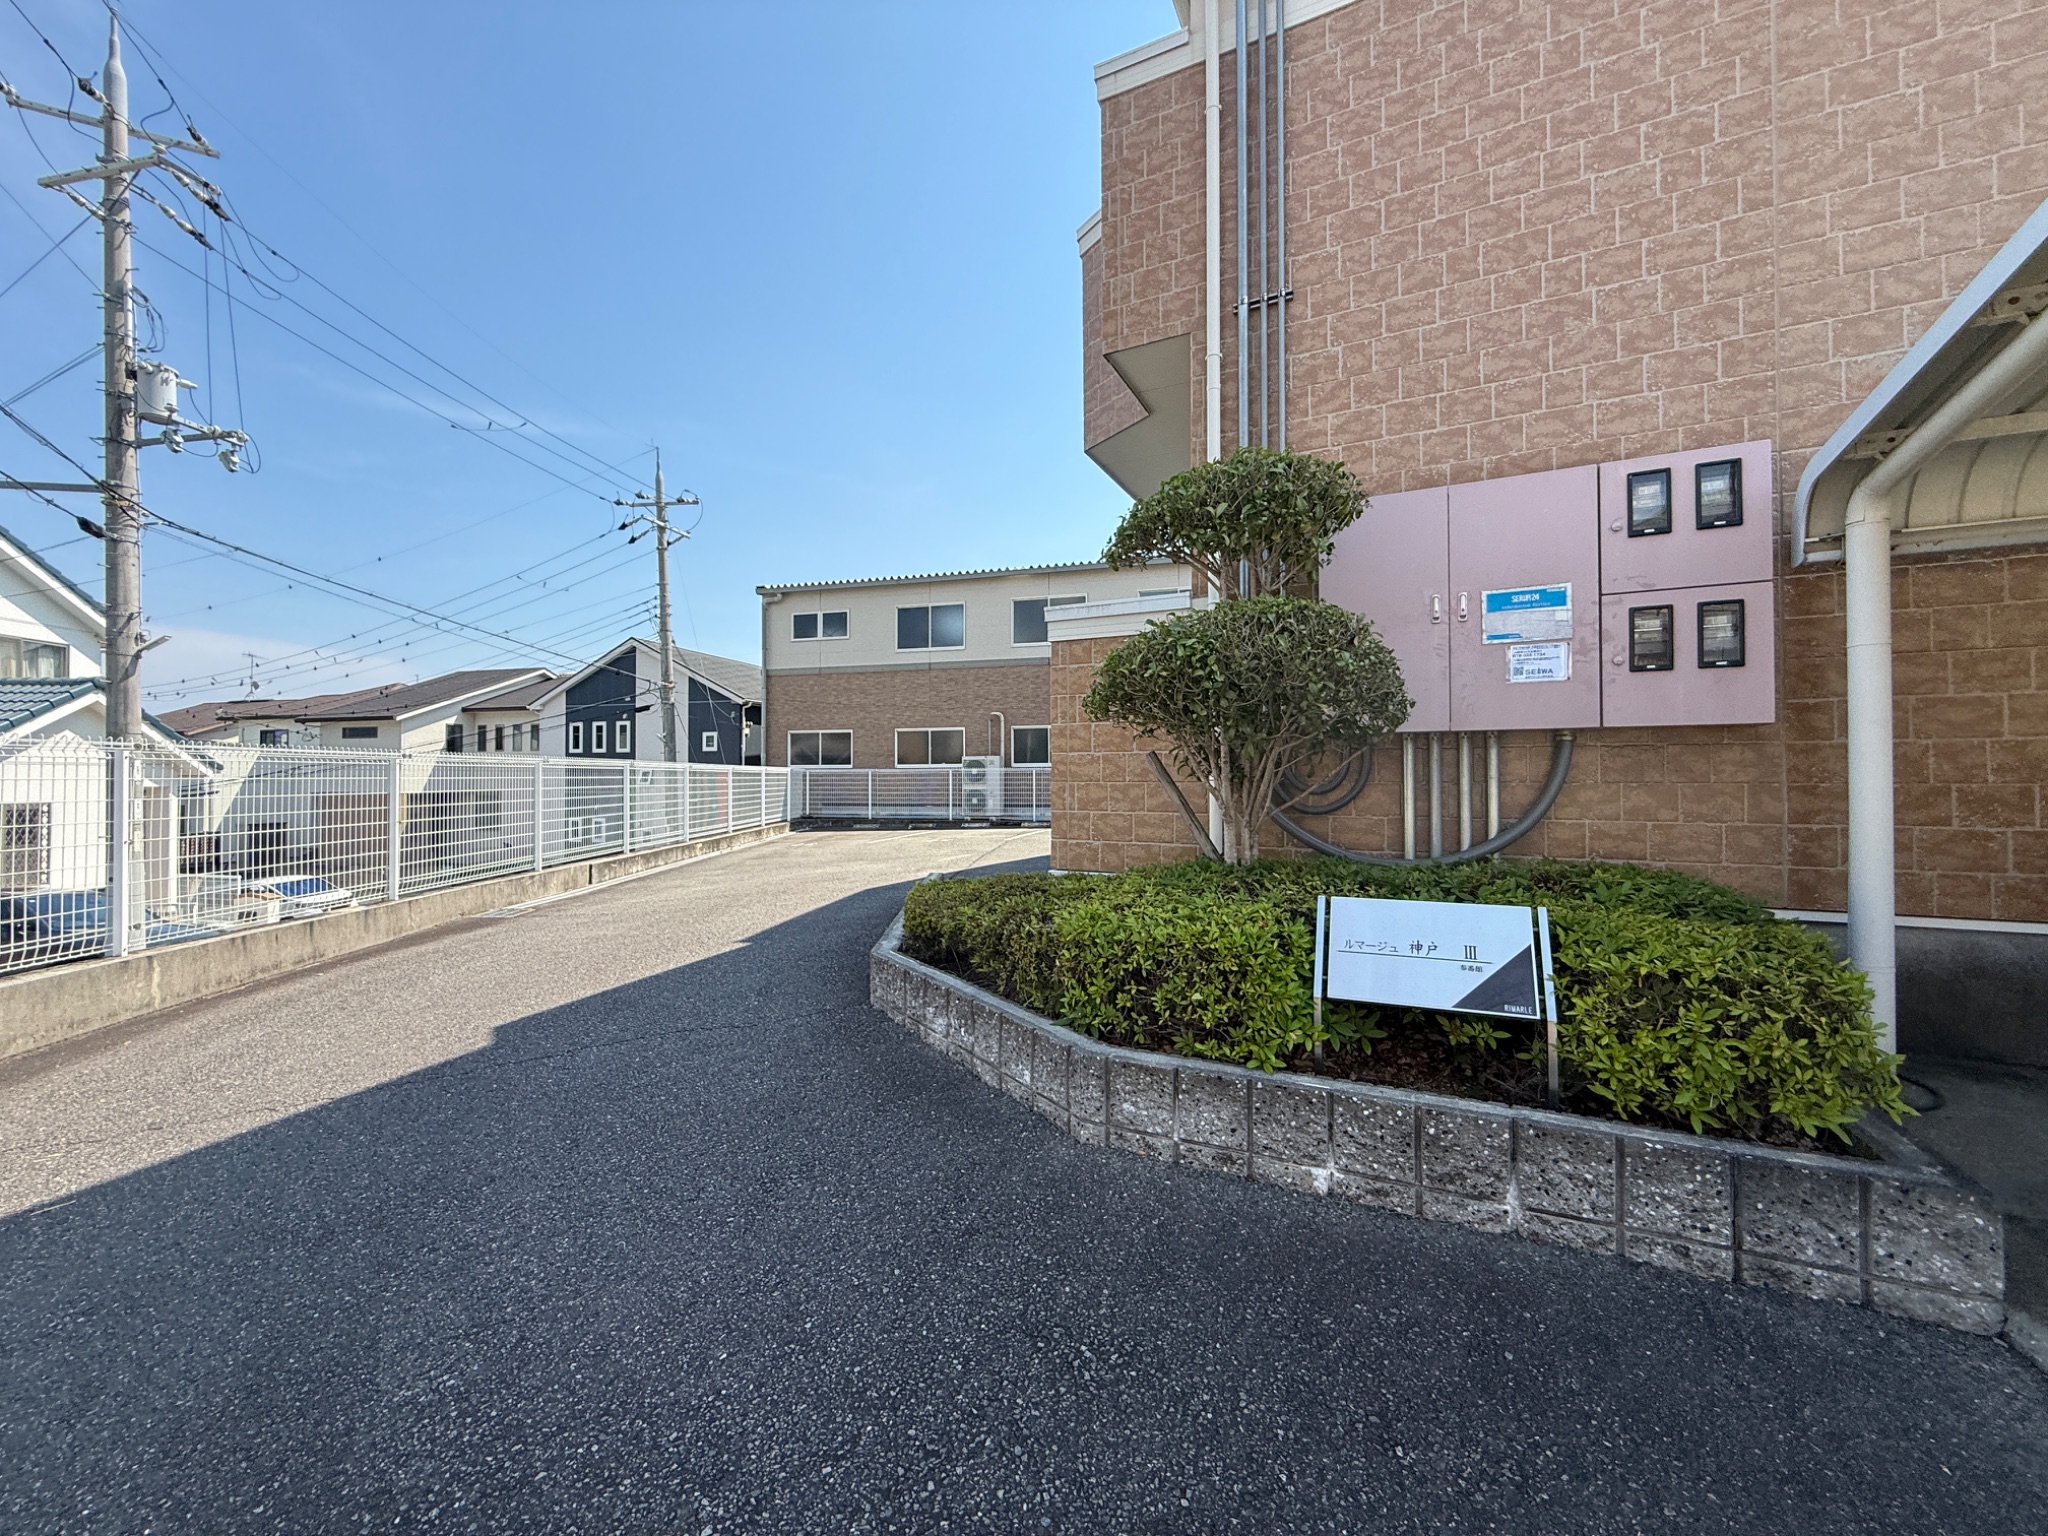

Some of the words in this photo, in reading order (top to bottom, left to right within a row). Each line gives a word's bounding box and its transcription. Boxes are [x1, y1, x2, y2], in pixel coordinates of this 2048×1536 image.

[1344, 939, 1399, 953] ルマージュ
[1408, 939, 1439, 956] 神戸
